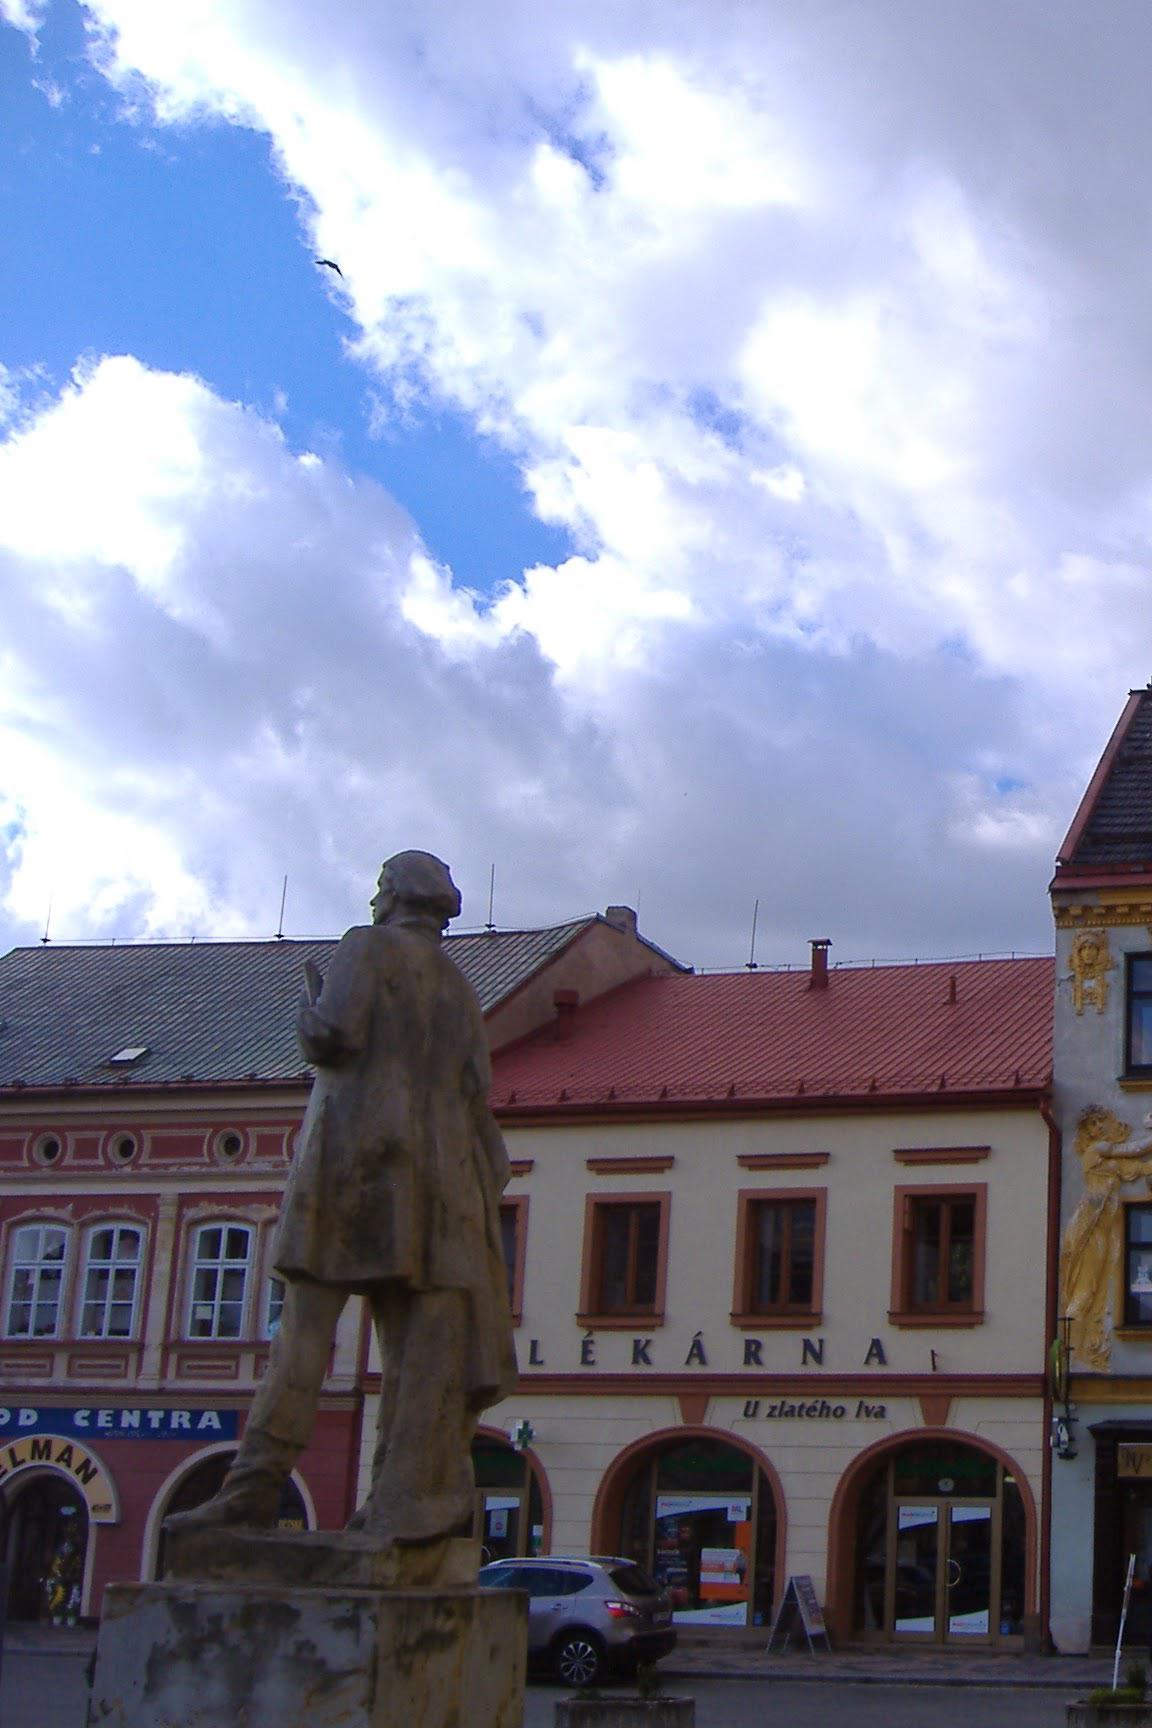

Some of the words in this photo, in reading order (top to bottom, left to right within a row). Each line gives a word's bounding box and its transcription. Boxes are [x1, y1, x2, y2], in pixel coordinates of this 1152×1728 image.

[528, 1331, 888, 1367] LÉKÁRNA
[73, 1409, 222, 1430] CENTRA
[743, 1401, 757, 1419] U
[765, 1400, 847, 1419] zlatého
[855, 1400, 887, 1419] lva
